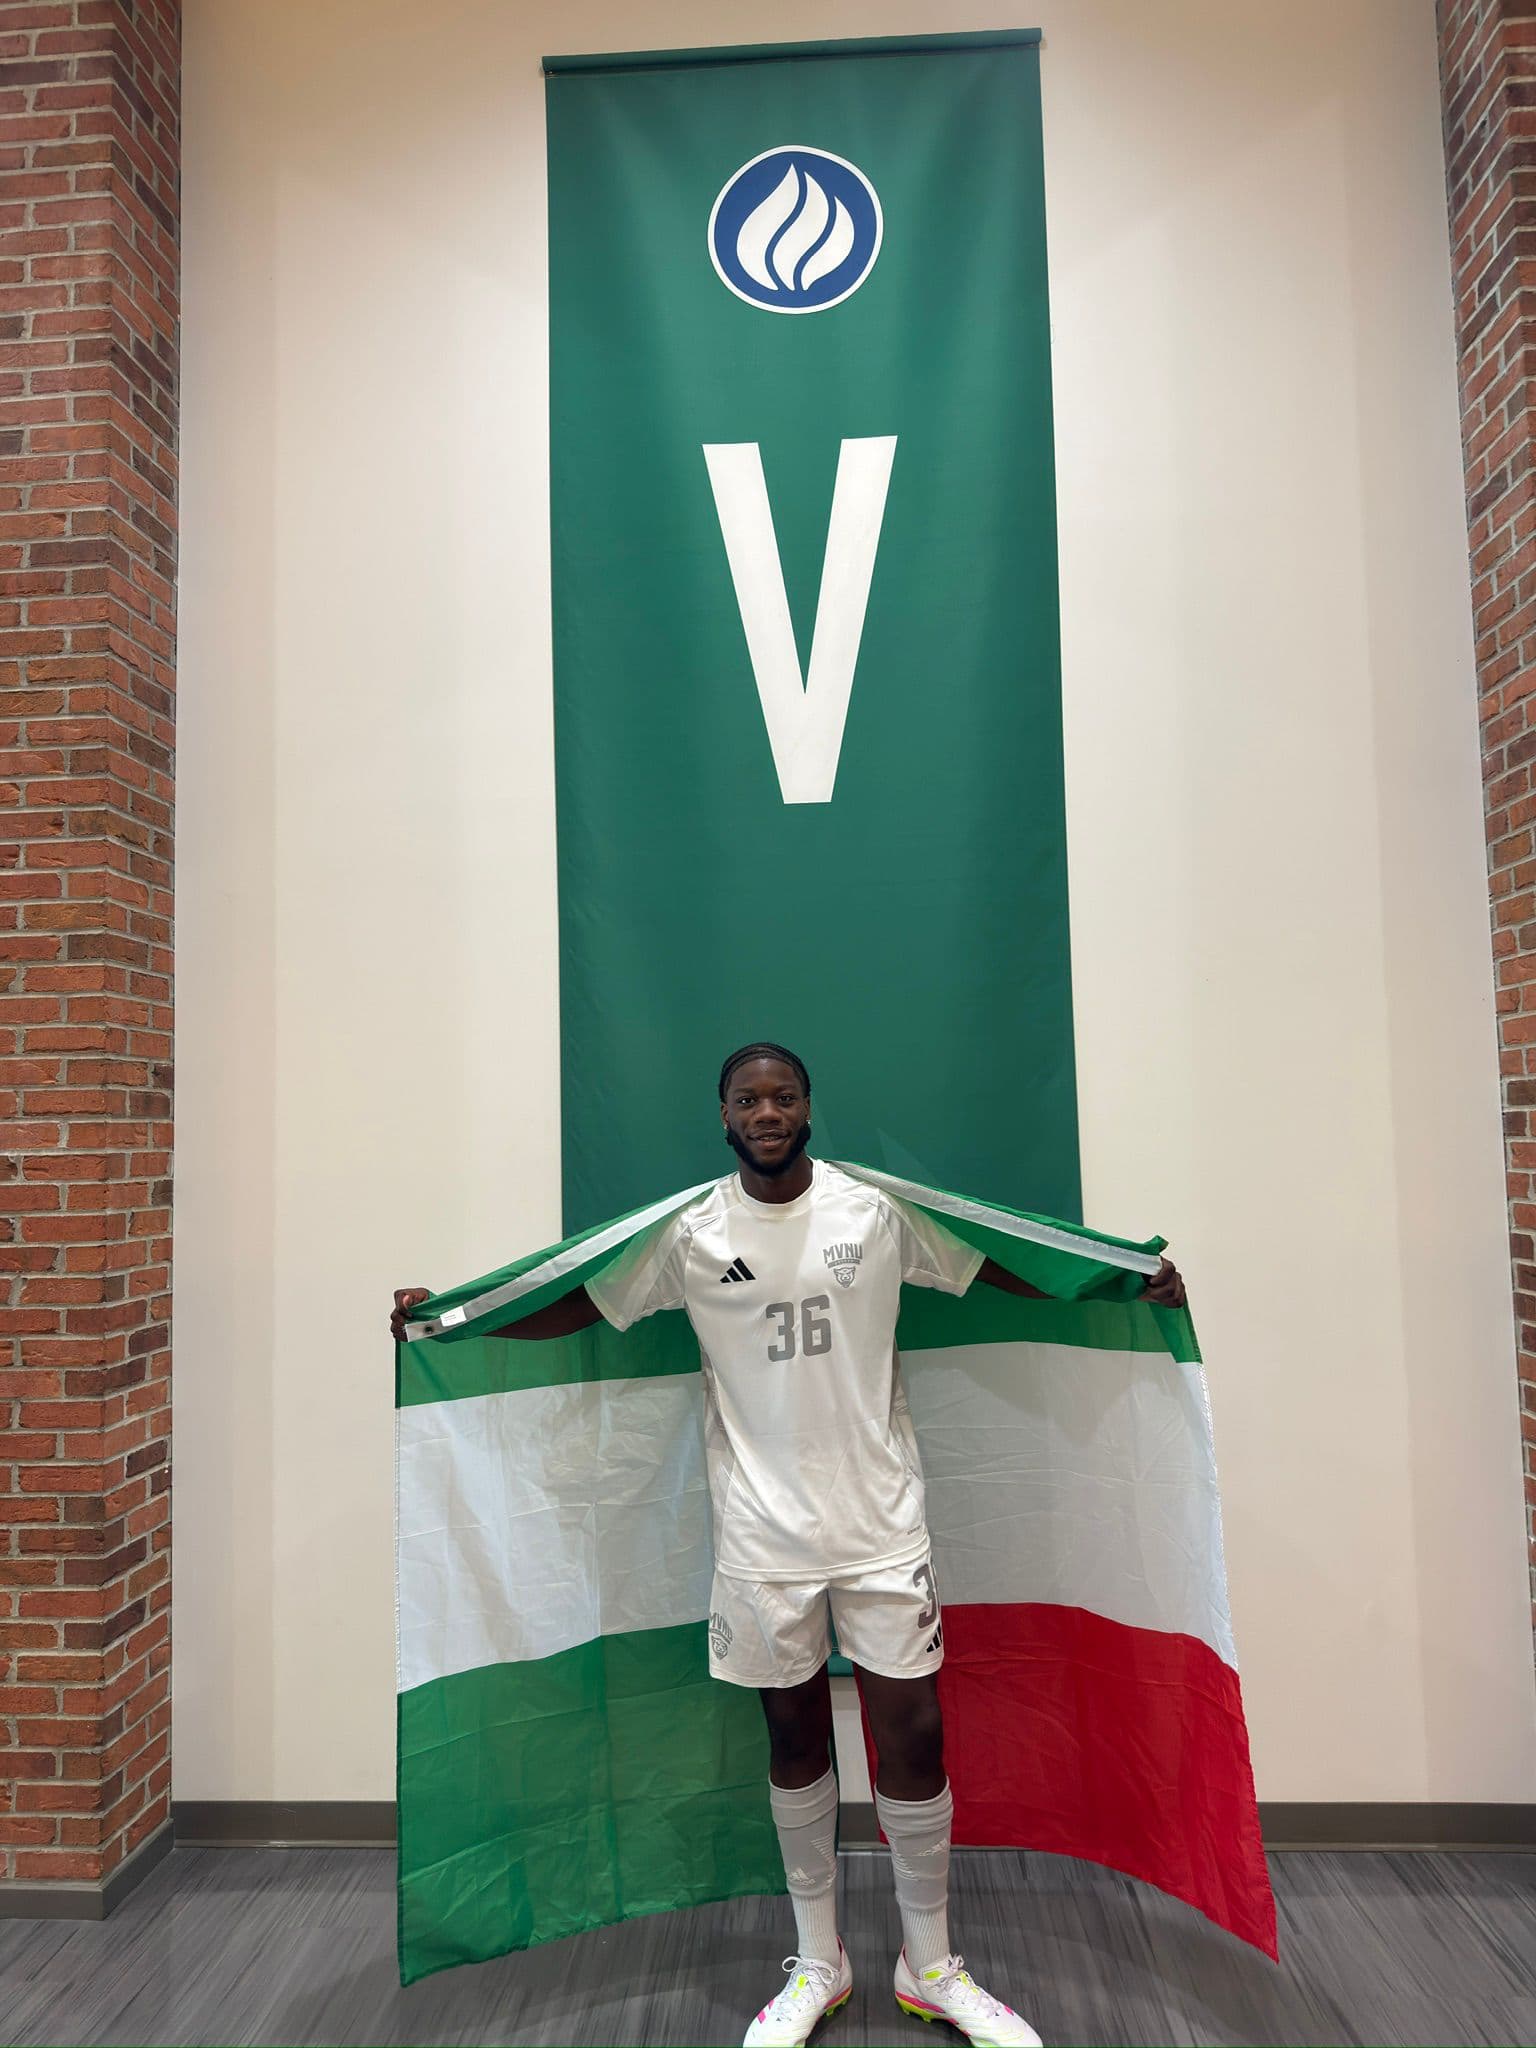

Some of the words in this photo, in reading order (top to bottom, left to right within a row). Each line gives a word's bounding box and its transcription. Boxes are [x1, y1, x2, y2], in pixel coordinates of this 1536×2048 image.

[702, 435, 898, 804] V
[822, 1243, 863, 1264] MVNU
[766, 1294, 832, 1362] 36
